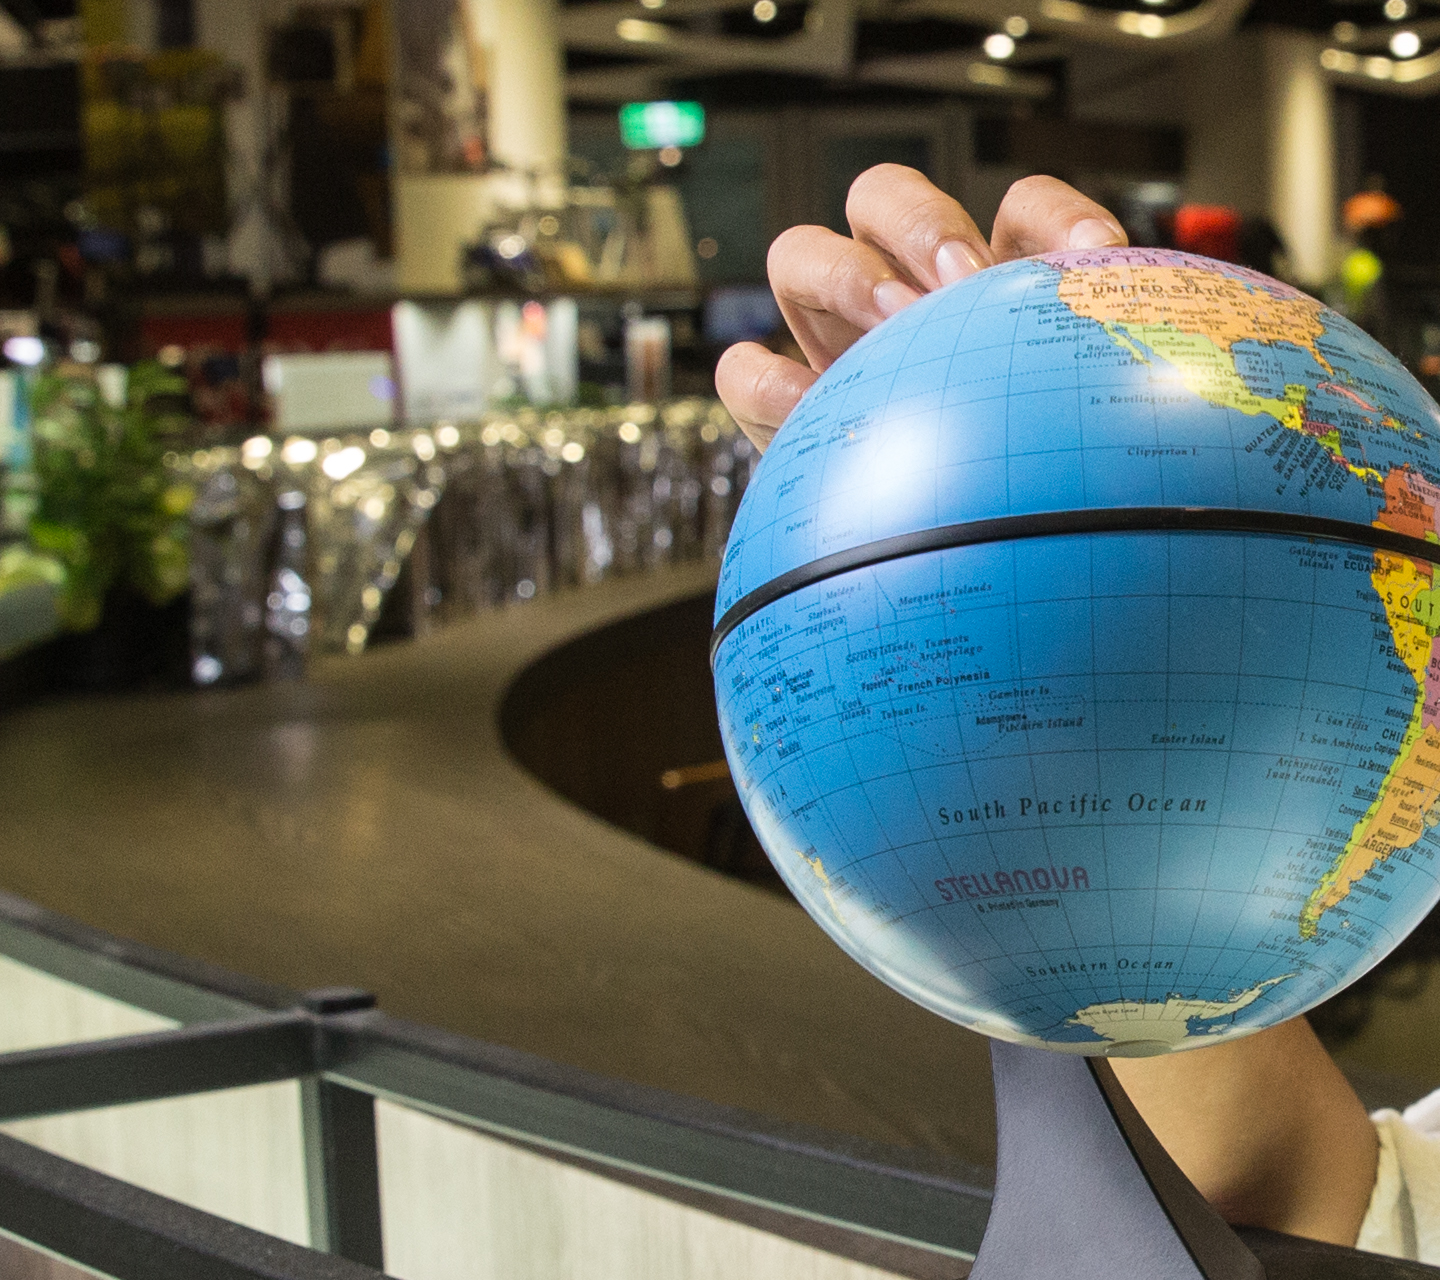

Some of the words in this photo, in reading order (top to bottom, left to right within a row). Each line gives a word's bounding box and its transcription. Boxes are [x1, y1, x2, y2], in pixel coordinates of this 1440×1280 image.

[1092, 284, 1164, 295] UNITED
[1171, 284, 1239, 300] STATES
[1343, 560, 1392, 577] ECUADOR
[898, 589, 951, 607] Marquesas
[953, 582, 993, 597] Islands
[1378, 643, 1407, 662] PERU
[897, 678, 934, 694] French
[935, 669, 991, 687] Polynesia
[1150, 732, 1188, 746] Easter
[1189, 732, 1227, 746] Island
[1381, 727, 1414, 747] CHILE
[937, 799, 1007, 827] South
[1018, 792, 1113, 819] Pacific
[1126, 792, 1208, 814] Ocean
[1362, 836, 1414, 864] ARGENTINA
[933, 865, 1091, 903] STELLANOVA
[1025, 961, 1109, 979] Southern
[1116, 956, 1175, 971] Ocean
